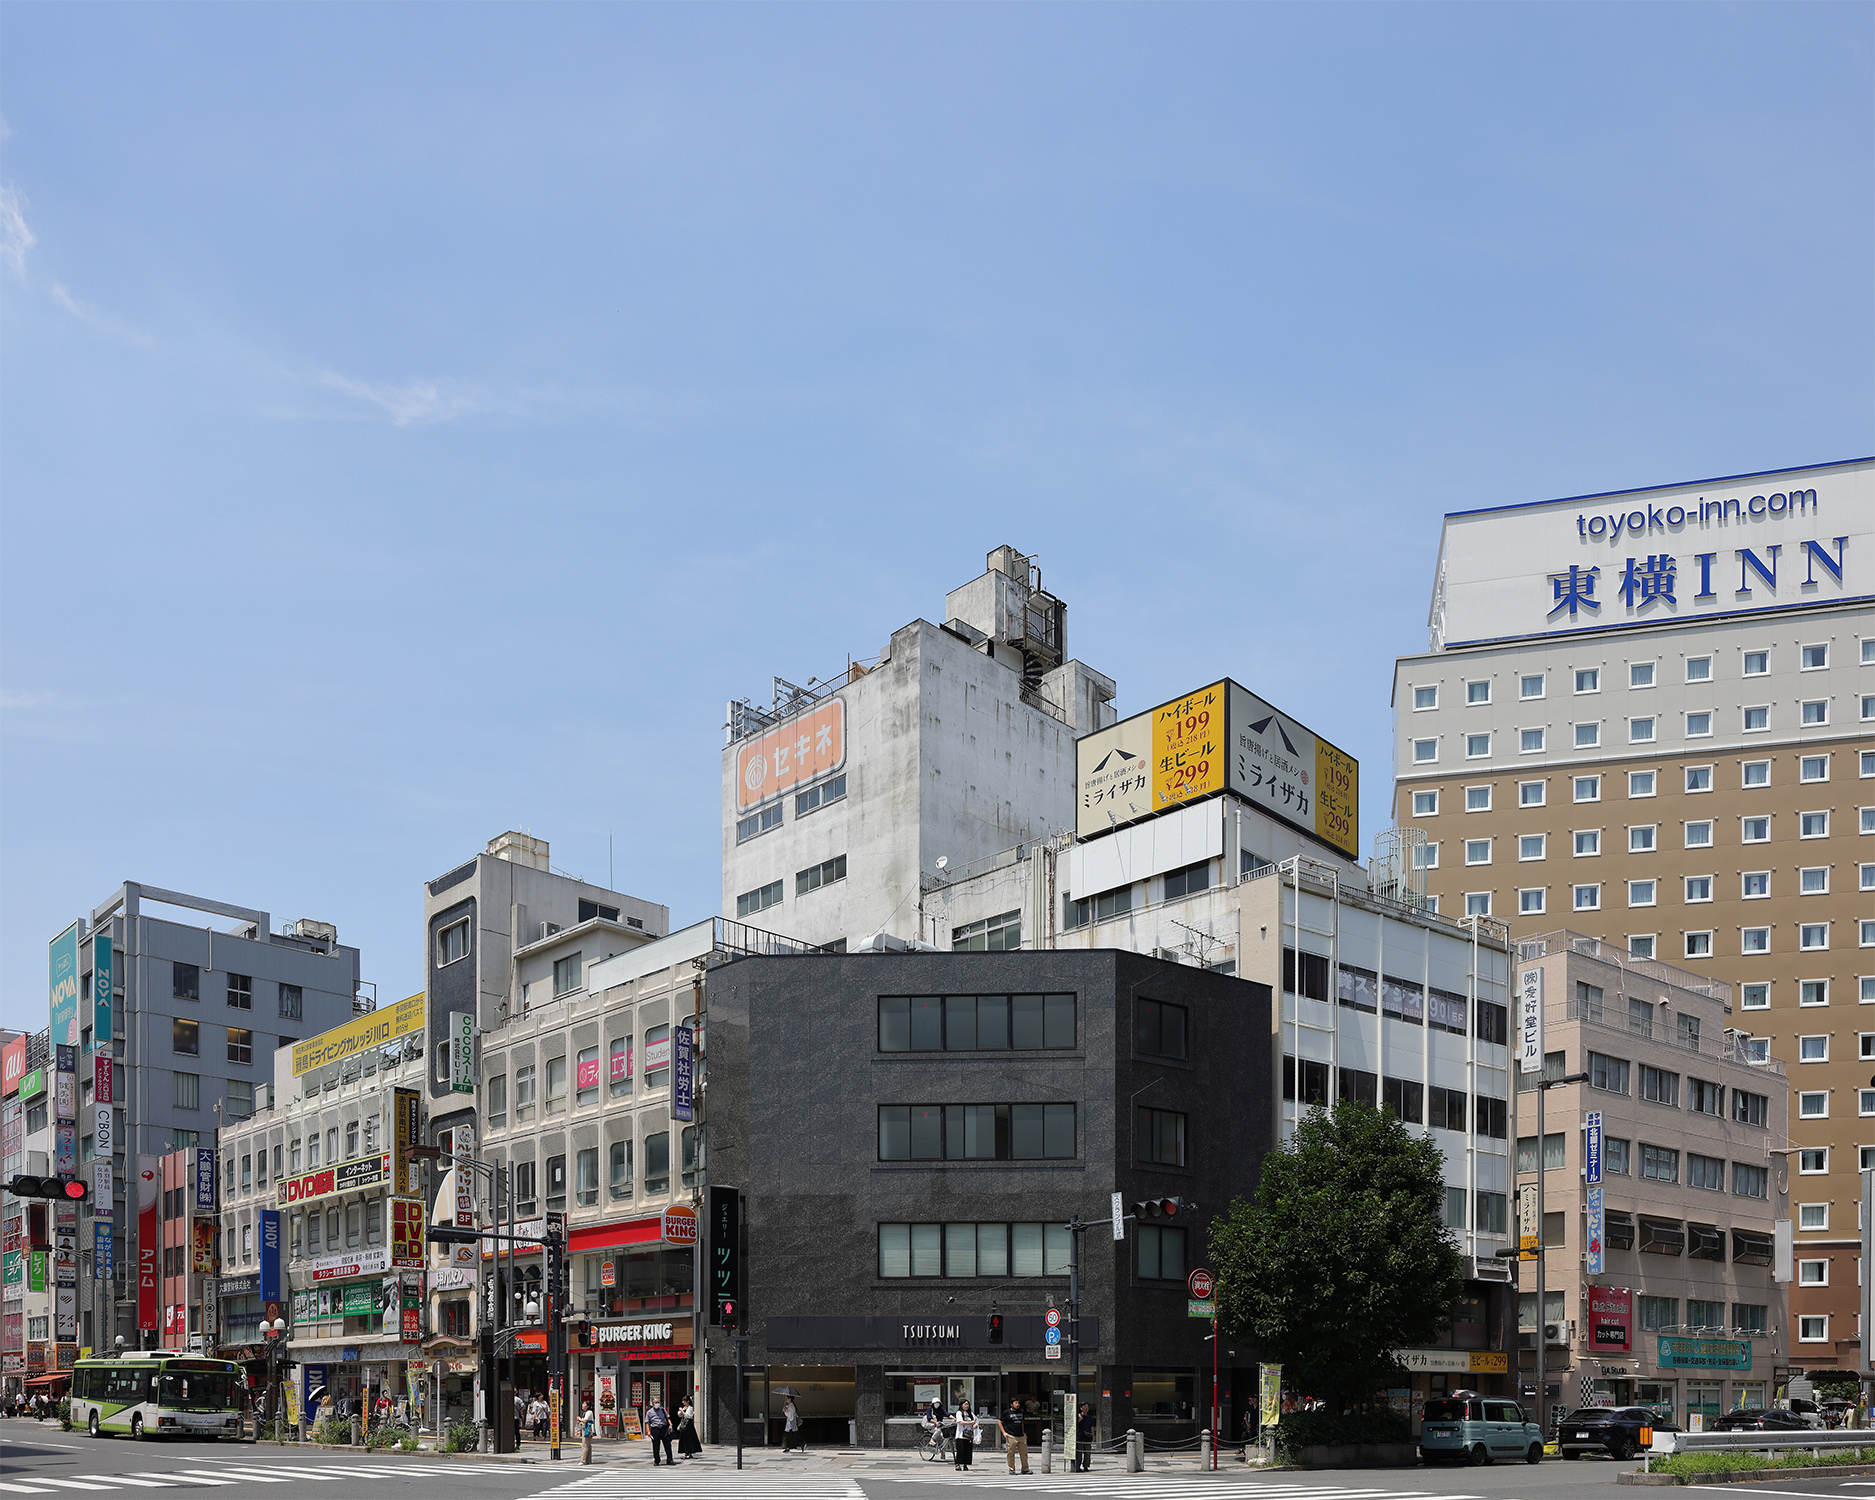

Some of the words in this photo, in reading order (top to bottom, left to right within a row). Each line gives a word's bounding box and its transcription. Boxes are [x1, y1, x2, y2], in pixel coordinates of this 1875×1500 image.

[1576, 487, 1817, 539] toyoko-inn.com
[1159, 692, 1217, 723] ハイボール
[773, 724, 832, 778] セキネ
[1159, 741, 1217, 774] 生ビール
[1320, 746, 1353, 774] ハイボール
[1083, 774, 1147, 809] ミライザカ
[1238, 754, 1309, 816] ミライザカ
[1320, 790, 1353, 818] 生ビール
[51, 975, 77, 1009] NOVA
[97, 967, 110, 1007] NOVA
[1451, 1012, 1463, 1023] 5F
[462, 1015, 472, 1085] COCOスーム
[5, 1050, 24, 1082] au
[677, 1030, 690, 1107] 佐賀社労士
[98, 1110, 110, 1149] C'BON
[288, 1169, 335, 1202] DVD鑑賞
[407, 1202, 422, 1259] DVD
[458, 1215, 471, 1223] 3F
[665, 1216, 696, 1227] BURGER
[665, 1225, 697, 1238] KING
[265, 1221, 277, 1249] AOKI
[33, 1254, 42, 1275] レイク
[141, 1249, 154, 1287] アコム
[1592, 1300, 1605, 1313] Cut
[1606, 1301, 1628, 1314] Studio
[1600, 1317, 1610, 1325] hair
[599, 1325, 643, 1343] BURGER
[643, 1323, 673, 1340] KING
[903, 1325, 960, 1339] TSUTSUMI
[1596, 1331, 1625, 1340] カット専門店
[620, 1352, 636, 1360] FLAME
[636, 1352, 661, 1360] GRILLING
[661, 1351, 677, 1359] SINCE
[677, 1350, 690, 1359] 1954
[1471, 1355, 1489, 1366] 生ビール
[1602, 1366, 1610, 1374] Cut
[1611, 1367, 1627, 1375] Studio
